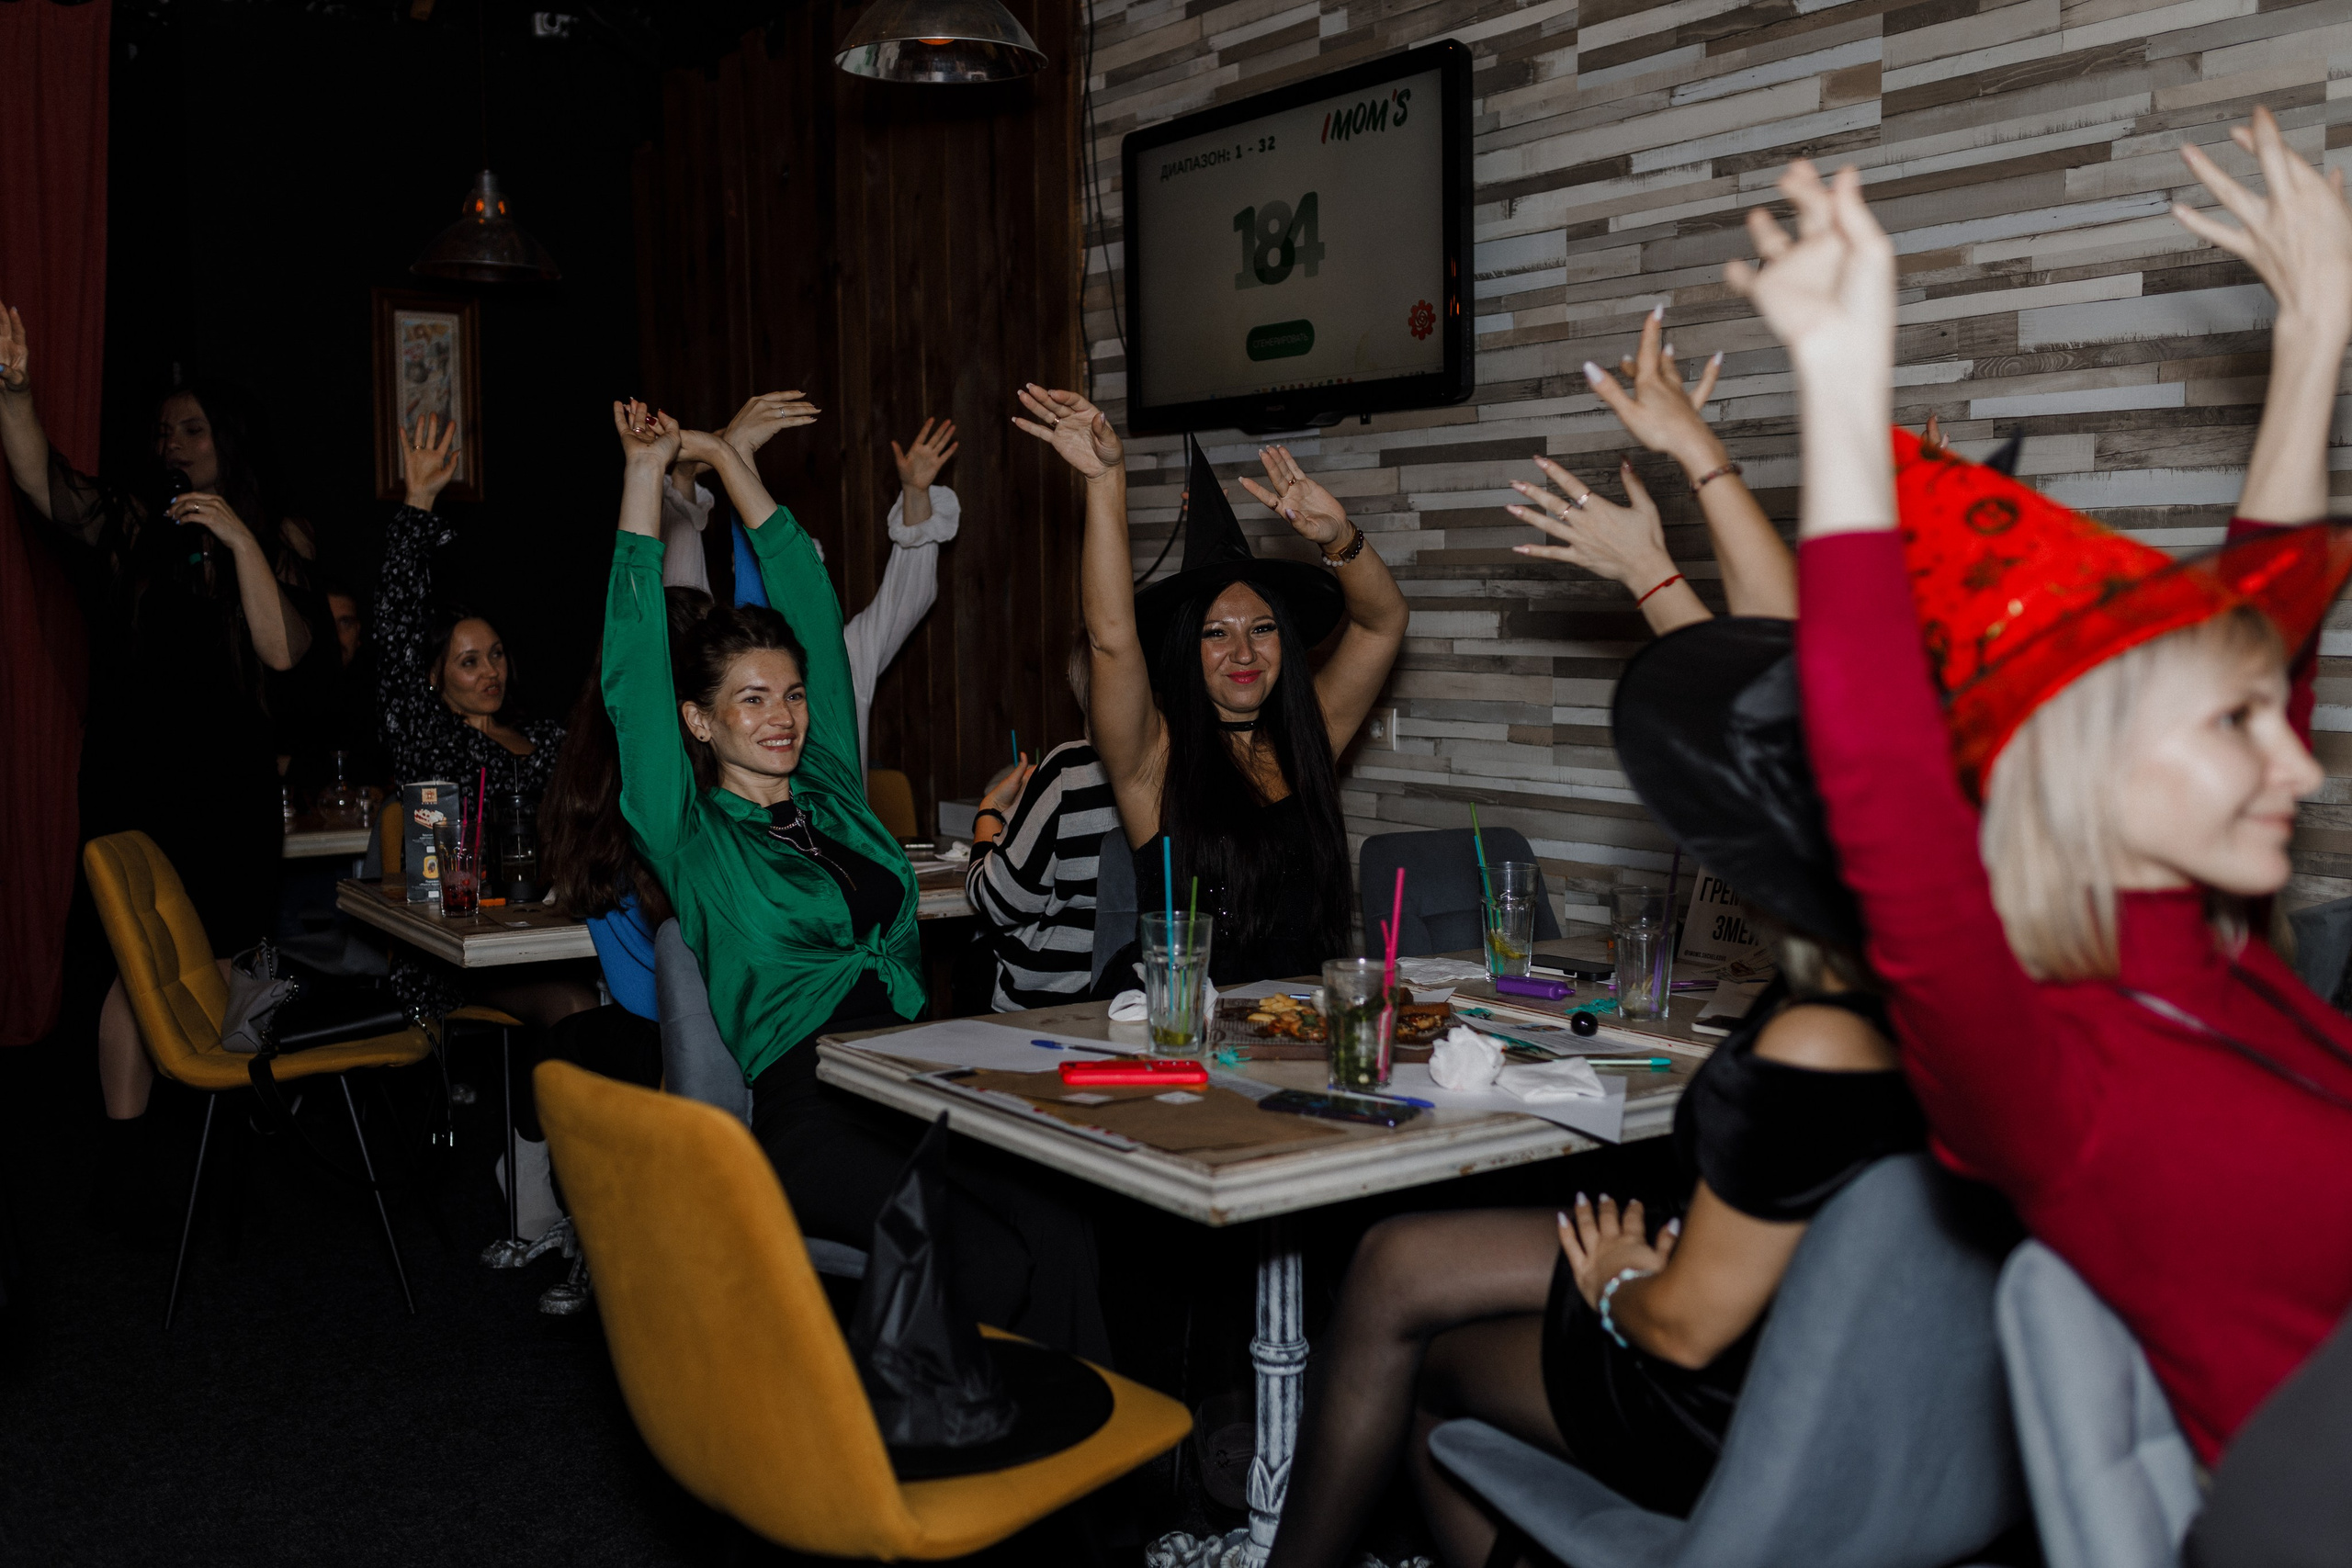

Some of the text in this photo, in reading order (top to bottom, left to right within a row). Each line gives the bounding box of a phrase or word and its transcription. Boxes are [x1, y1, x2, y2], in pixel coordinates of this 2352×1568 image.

[1160, 148, 1230, 183] ДИАПАЗОН:
[1235, 144, 1242, 159] 1
[1258, 135, 1275, 152] 32
[1233, 191, 1325, 290] 184
[1252, 333, 1309, 349] СГЕНЕРИРОВАТЬ
